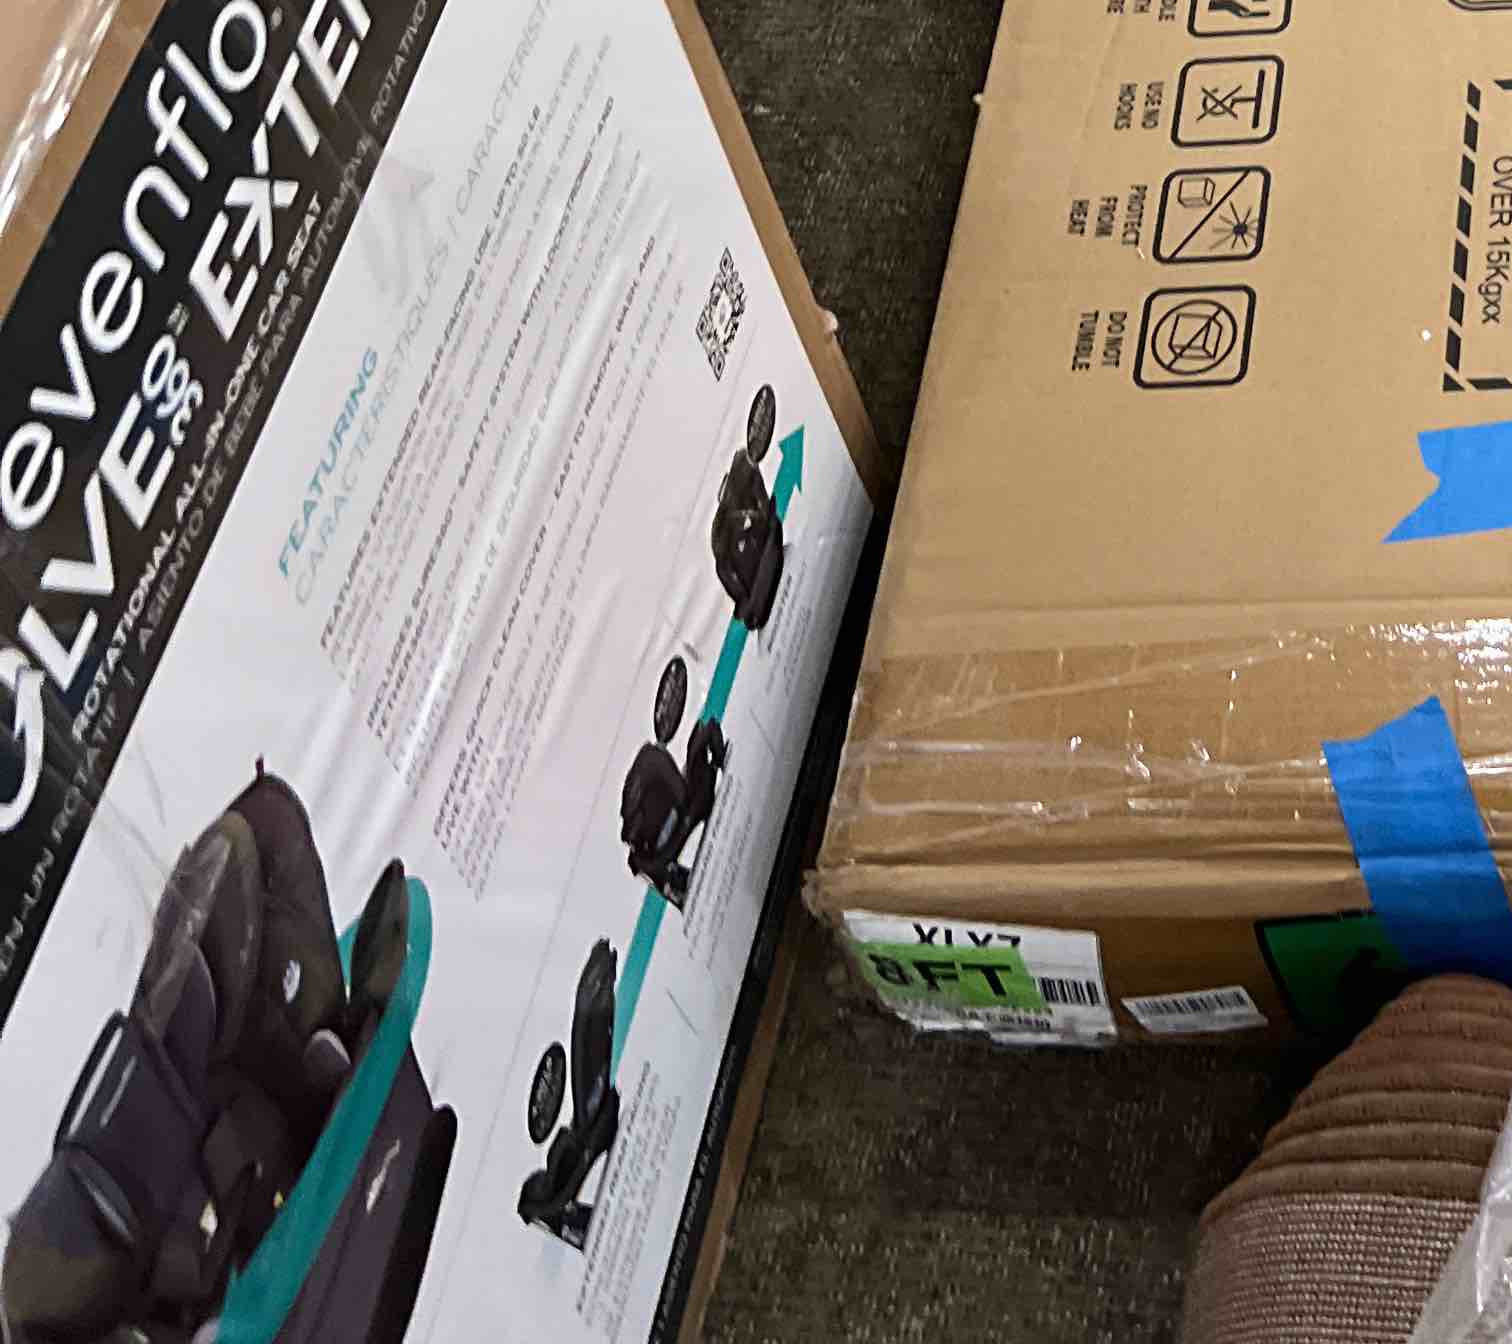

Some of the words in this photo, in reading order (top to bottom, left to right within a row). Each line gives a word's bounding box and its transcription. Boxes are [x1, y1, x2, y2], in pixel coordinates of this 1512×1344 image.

[1113, 82, 1138, 131] HOOKS
[1095, 196, 1118, 238] FROM
[1121, 184, 1148, 247] PROTECT
[1072, 310, 1099, 372] TUMBLE
[142, 334, 203, 447] 360
[69, 520, 176, 749] ROTATIONAL
[170, 334, 261, 525] ALL-IN-ONE
[254, 267, 292, 336] CAR
[283, 190, 326, 269] SEAT
[276, 340, 380, 582] FEATURING
[489, 595, 523, 671] CLEAN
[516, 522, 549, 596] COVER
[552, 448, 577, 502] EASY
